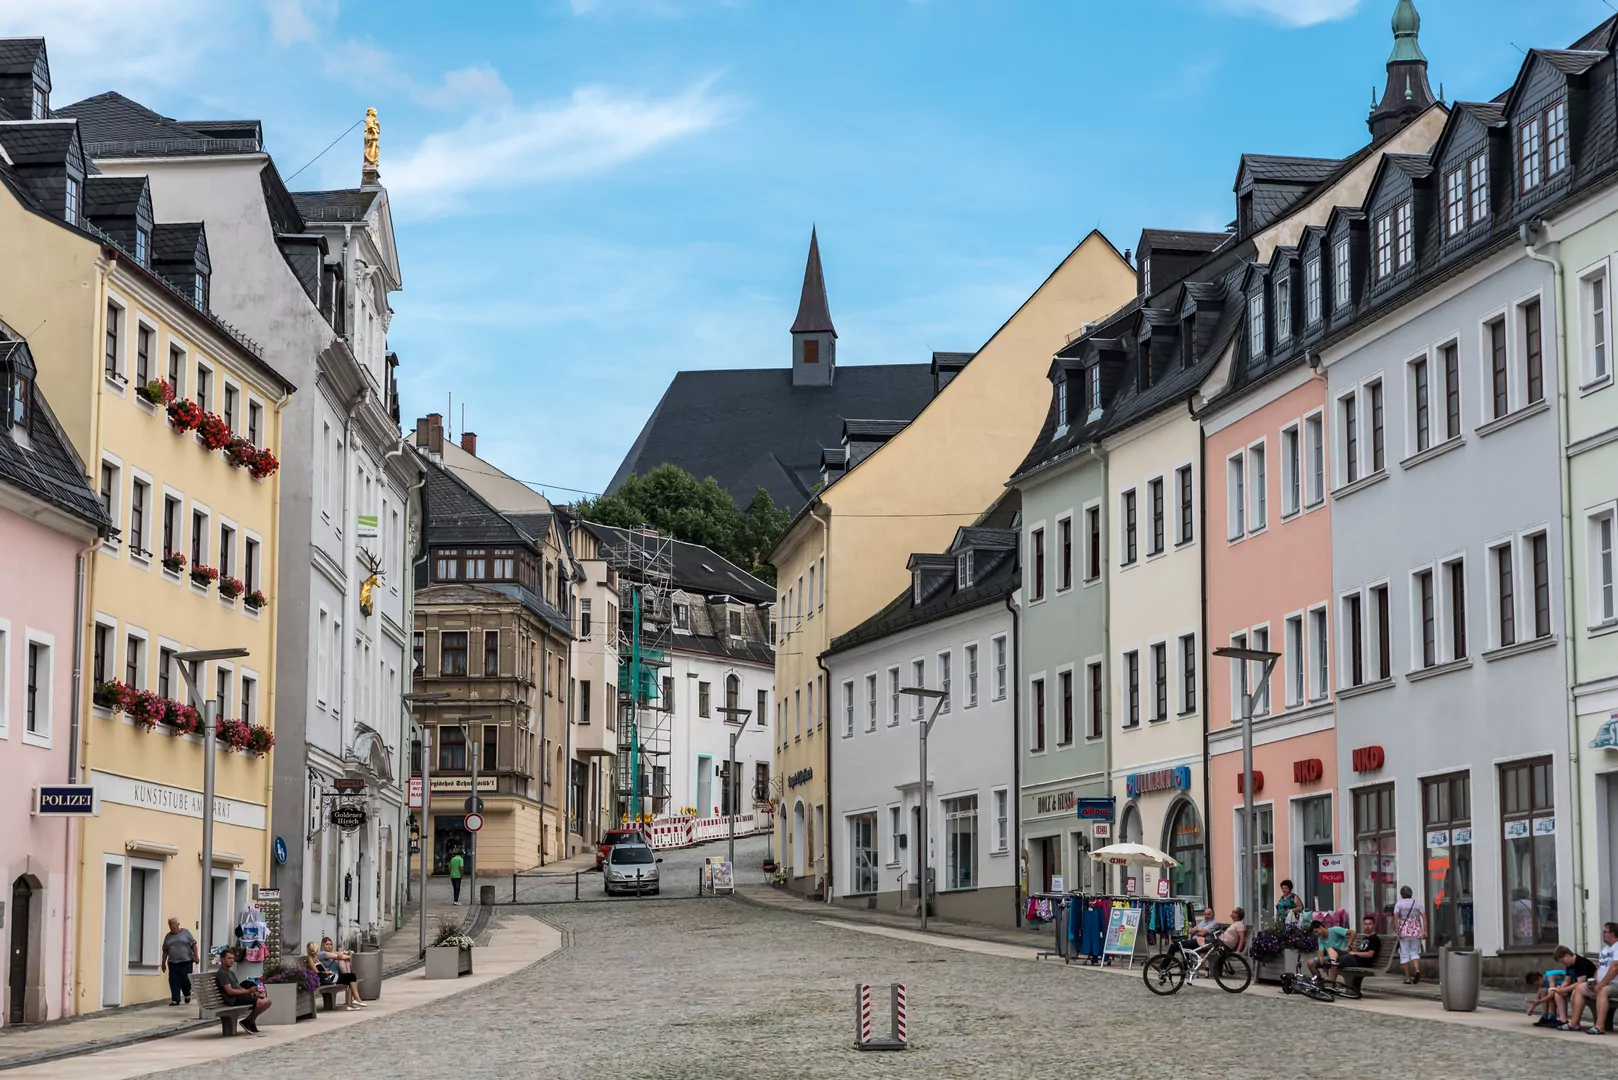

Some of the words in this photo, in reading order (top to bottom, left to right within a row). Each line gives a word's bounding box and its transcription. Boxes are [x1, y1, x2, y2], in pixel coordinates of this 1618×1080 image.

[1293, 758, 1323, 783] NKD
[1352, 746, 1385, 772] NKD
[1237, 770, 1264, 793] ND
[41, 794, 91, 806] POLIZEI
[134, 784, 188, 811] KUNSTSTUBE
[191, 796, 203, 812] AM
[212, 800, 231, 818] ARKT
